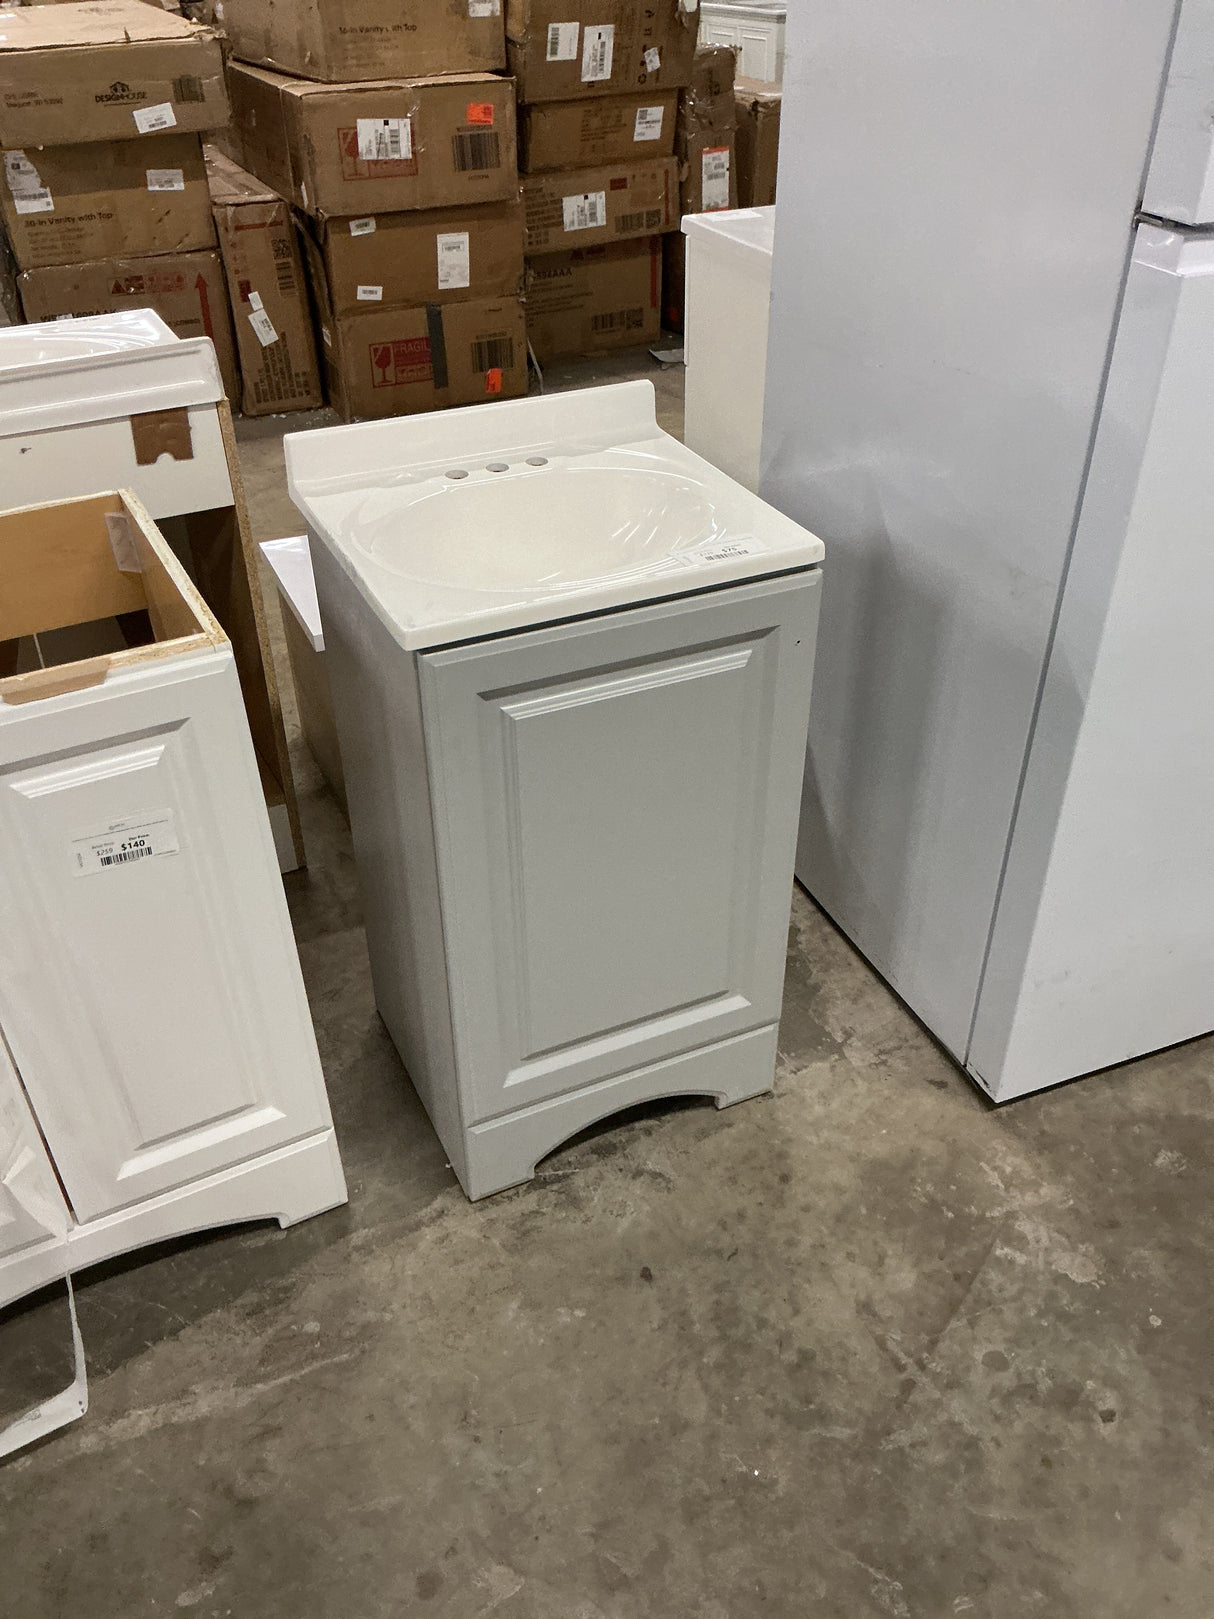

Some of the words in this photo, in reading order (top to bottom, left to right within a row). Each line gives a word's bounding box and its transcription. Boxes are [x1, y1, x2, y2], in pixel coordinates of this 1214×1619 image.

[403, 23, 418, 32] Top
[48, 216, 75, 226] Vanity
[77, 213, 96, 222] with
[97, 211, 113, 220] Top
[393, 339, 431, 355] FRAGIL
[96, 847, 114, 857] $259
[121, 840, 146, 851] $140
